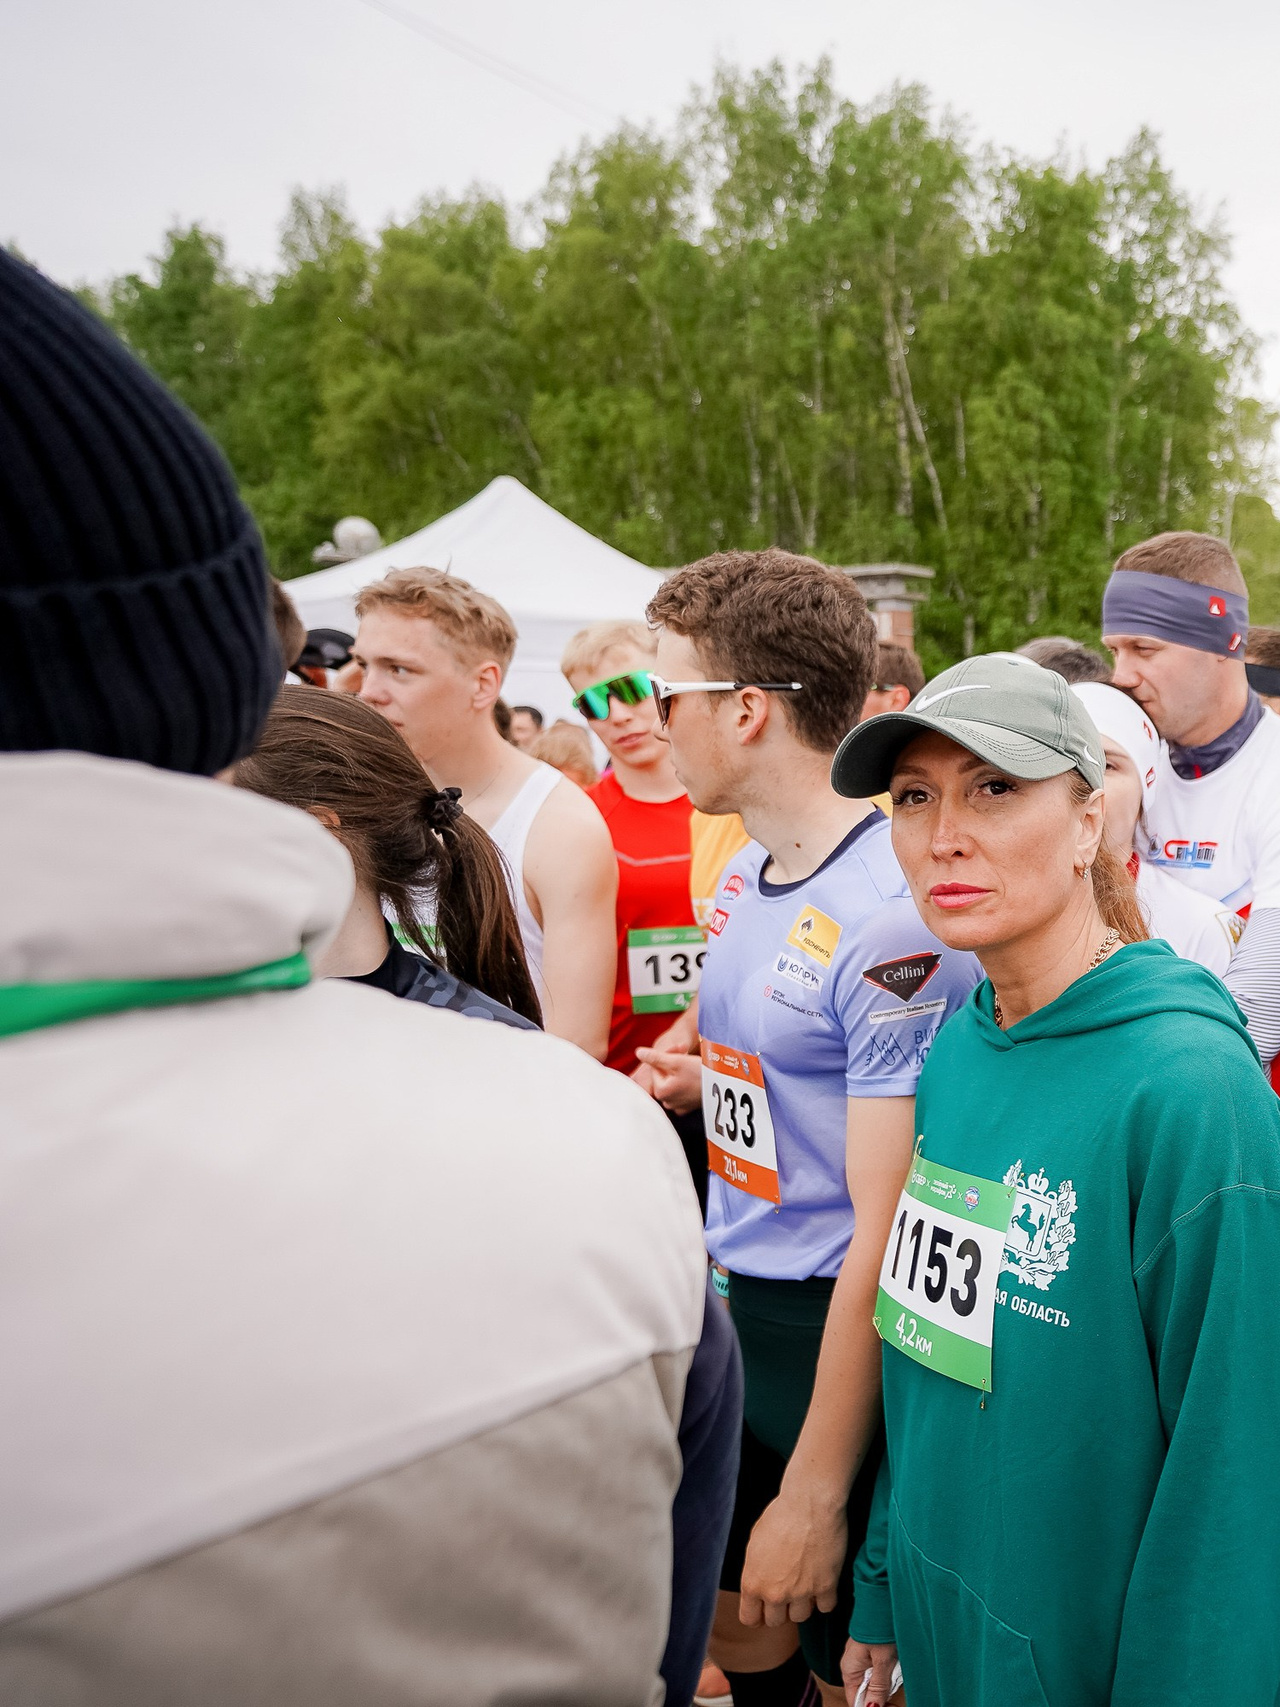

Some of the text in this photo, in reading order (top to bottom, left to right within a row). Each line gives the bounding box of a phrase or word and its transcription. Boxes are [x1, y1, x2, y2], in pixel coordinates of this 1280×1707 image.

[883, 964, 926, 983] Cellini
[712, 1083, 756, 1149] 233
[891, 1209, 982, 1317] 1153
[1010, 1295, 1071, 1328] ОБЛАСТЬ
